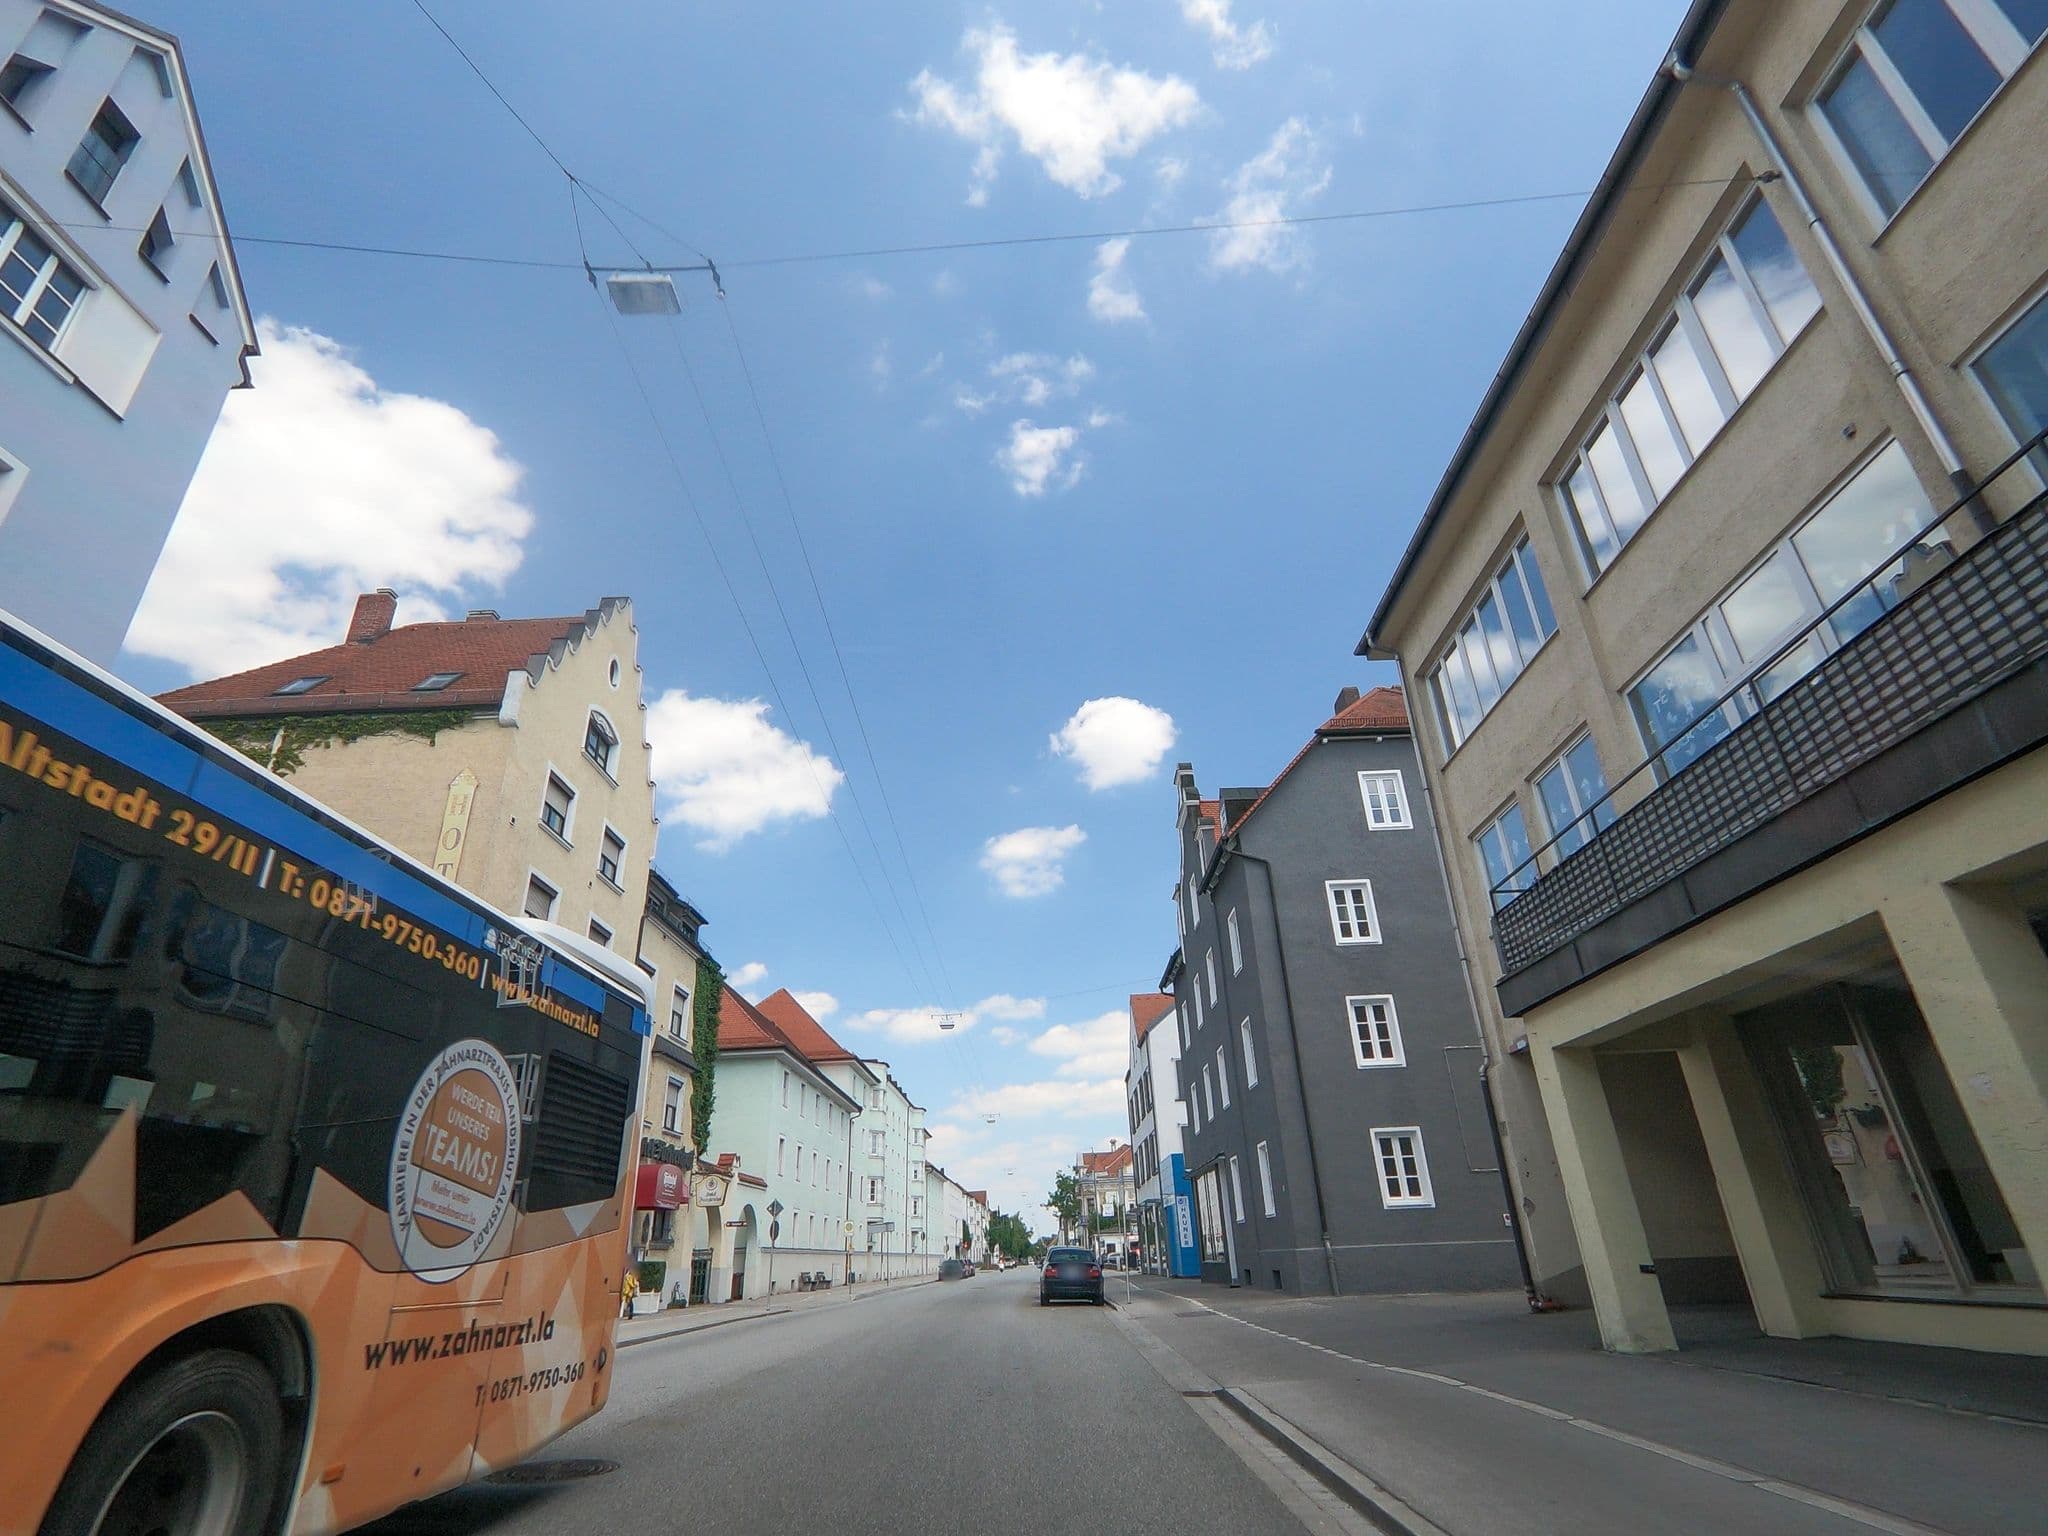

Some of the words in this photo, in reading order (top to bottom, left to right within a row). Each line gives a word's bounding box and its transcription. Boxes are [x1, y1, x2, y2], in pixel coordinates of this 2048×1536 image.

[280, 860, 305, 898] T:
[310, 878, 480, 981] 0871-9750-360
[415, 1077, 435, 1109] DER
[434, 1048, 510, 1093] ZAHNARZTPRAXIS
[404, 1113, 418, 1134] IN
[447, 1106, 490, 1141] UNSERES
[452, 1083, 485, 1114] WERDE
[485, 1102, 501, 1124] TEIL
[425, 1122, 498, 1186] TEAMS!
[504, 1094, 516, 1182] LANDSHUT
[473, 1185, 507, 1253] ALTSTADT
[365, 1311, 555, 1371] www.zahnarzt.la
[490, 1360, 585, 1404] 0871-9750-360
